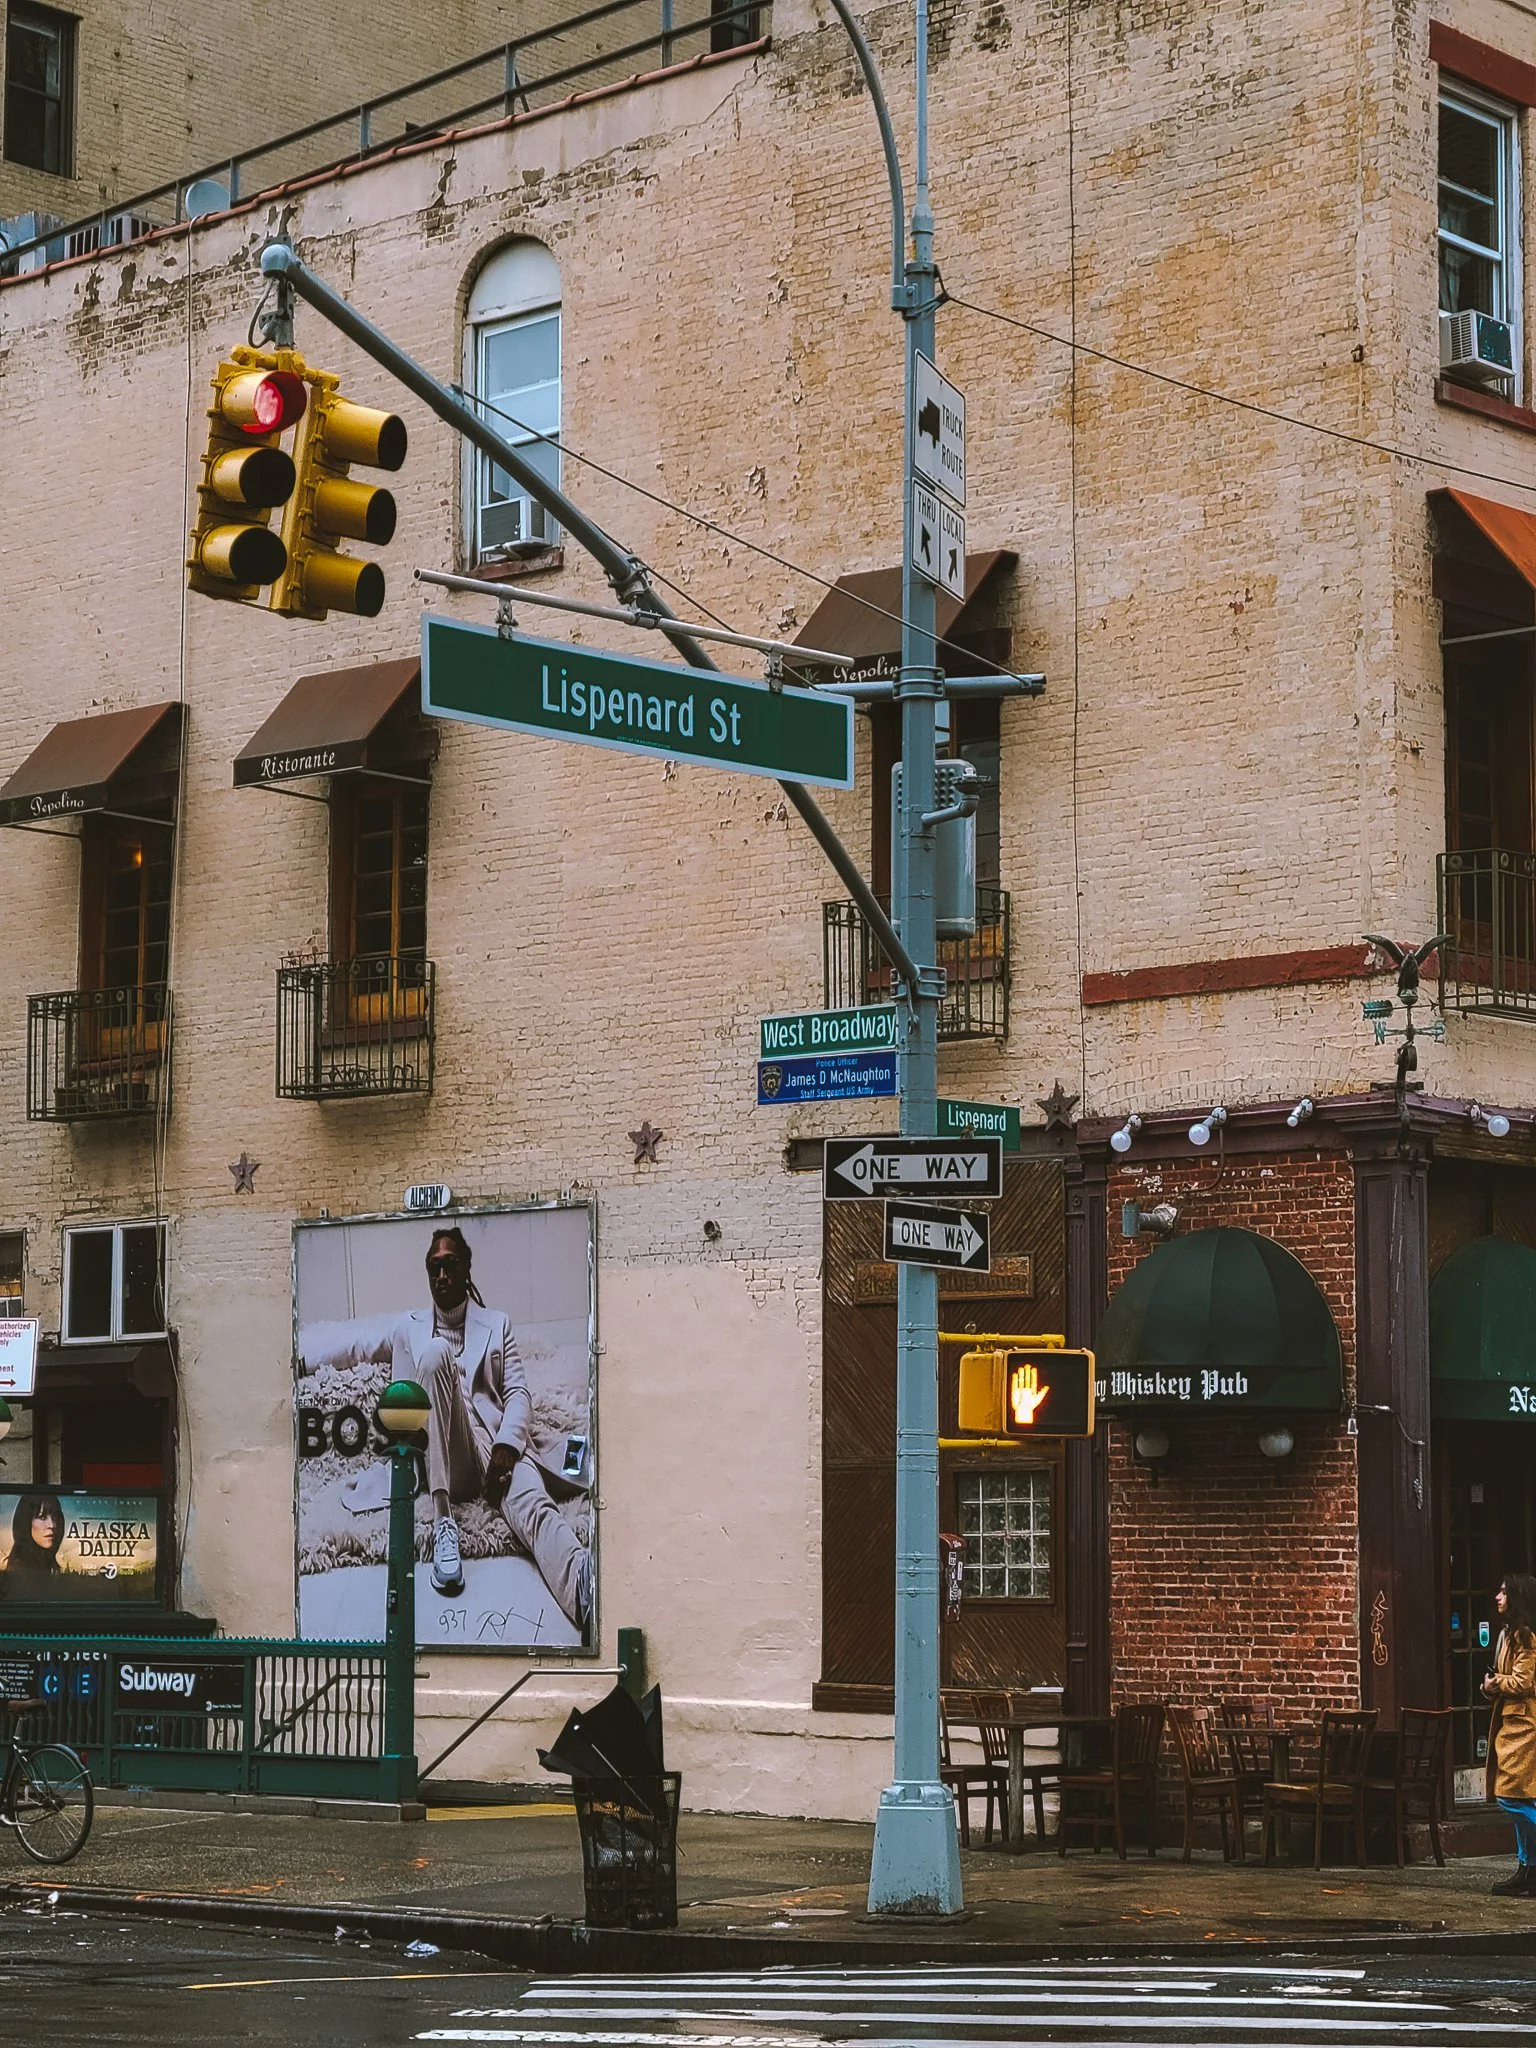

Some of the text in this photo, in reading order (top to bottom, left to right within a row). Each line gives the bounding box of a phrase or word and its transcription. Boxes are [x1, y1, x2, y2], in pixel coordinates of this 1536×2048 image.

[942, 404, 963, 441] TRUCK
[942, 444, 963, 480] ROUTE
[917, 490, 936, 524] THRU
[942, 508, 963, 545] LOCAL
[833, 656, 900, 684] Pepolin
[542, 664, 741, 746] Lispenard St
[260, 751, 336, 778] Ristorante
[30, 791, 84, 817] Pepolino
[764, 1012, 896, 1049] West Broadway
[785, 1068, 890, 1087] James D McNaughton
[816, 1059, 835, 1068] Police
[816, 1087, 845, 1099] Sergeant
[857, 1086, 874, 1097] Army
[948, 1104, 1007, 1132] Lispenard
[852, 1156, 977, 1180] ONE WAY
[901, 1221, 974, 1252] ONE WAY
[0, 1322, 31, 1330] uthorized
[0, 1330, 21, 1338] ehicles
[1111, 1371, 1192, 1400] Whiskey
[1200, 1369, 1248, 1400] Pub
[67, 1521, 151, 1540] ALASKA
[79, 1540, 139, 1558] DAILY
[119, 1664, 196, 1697] Subway
